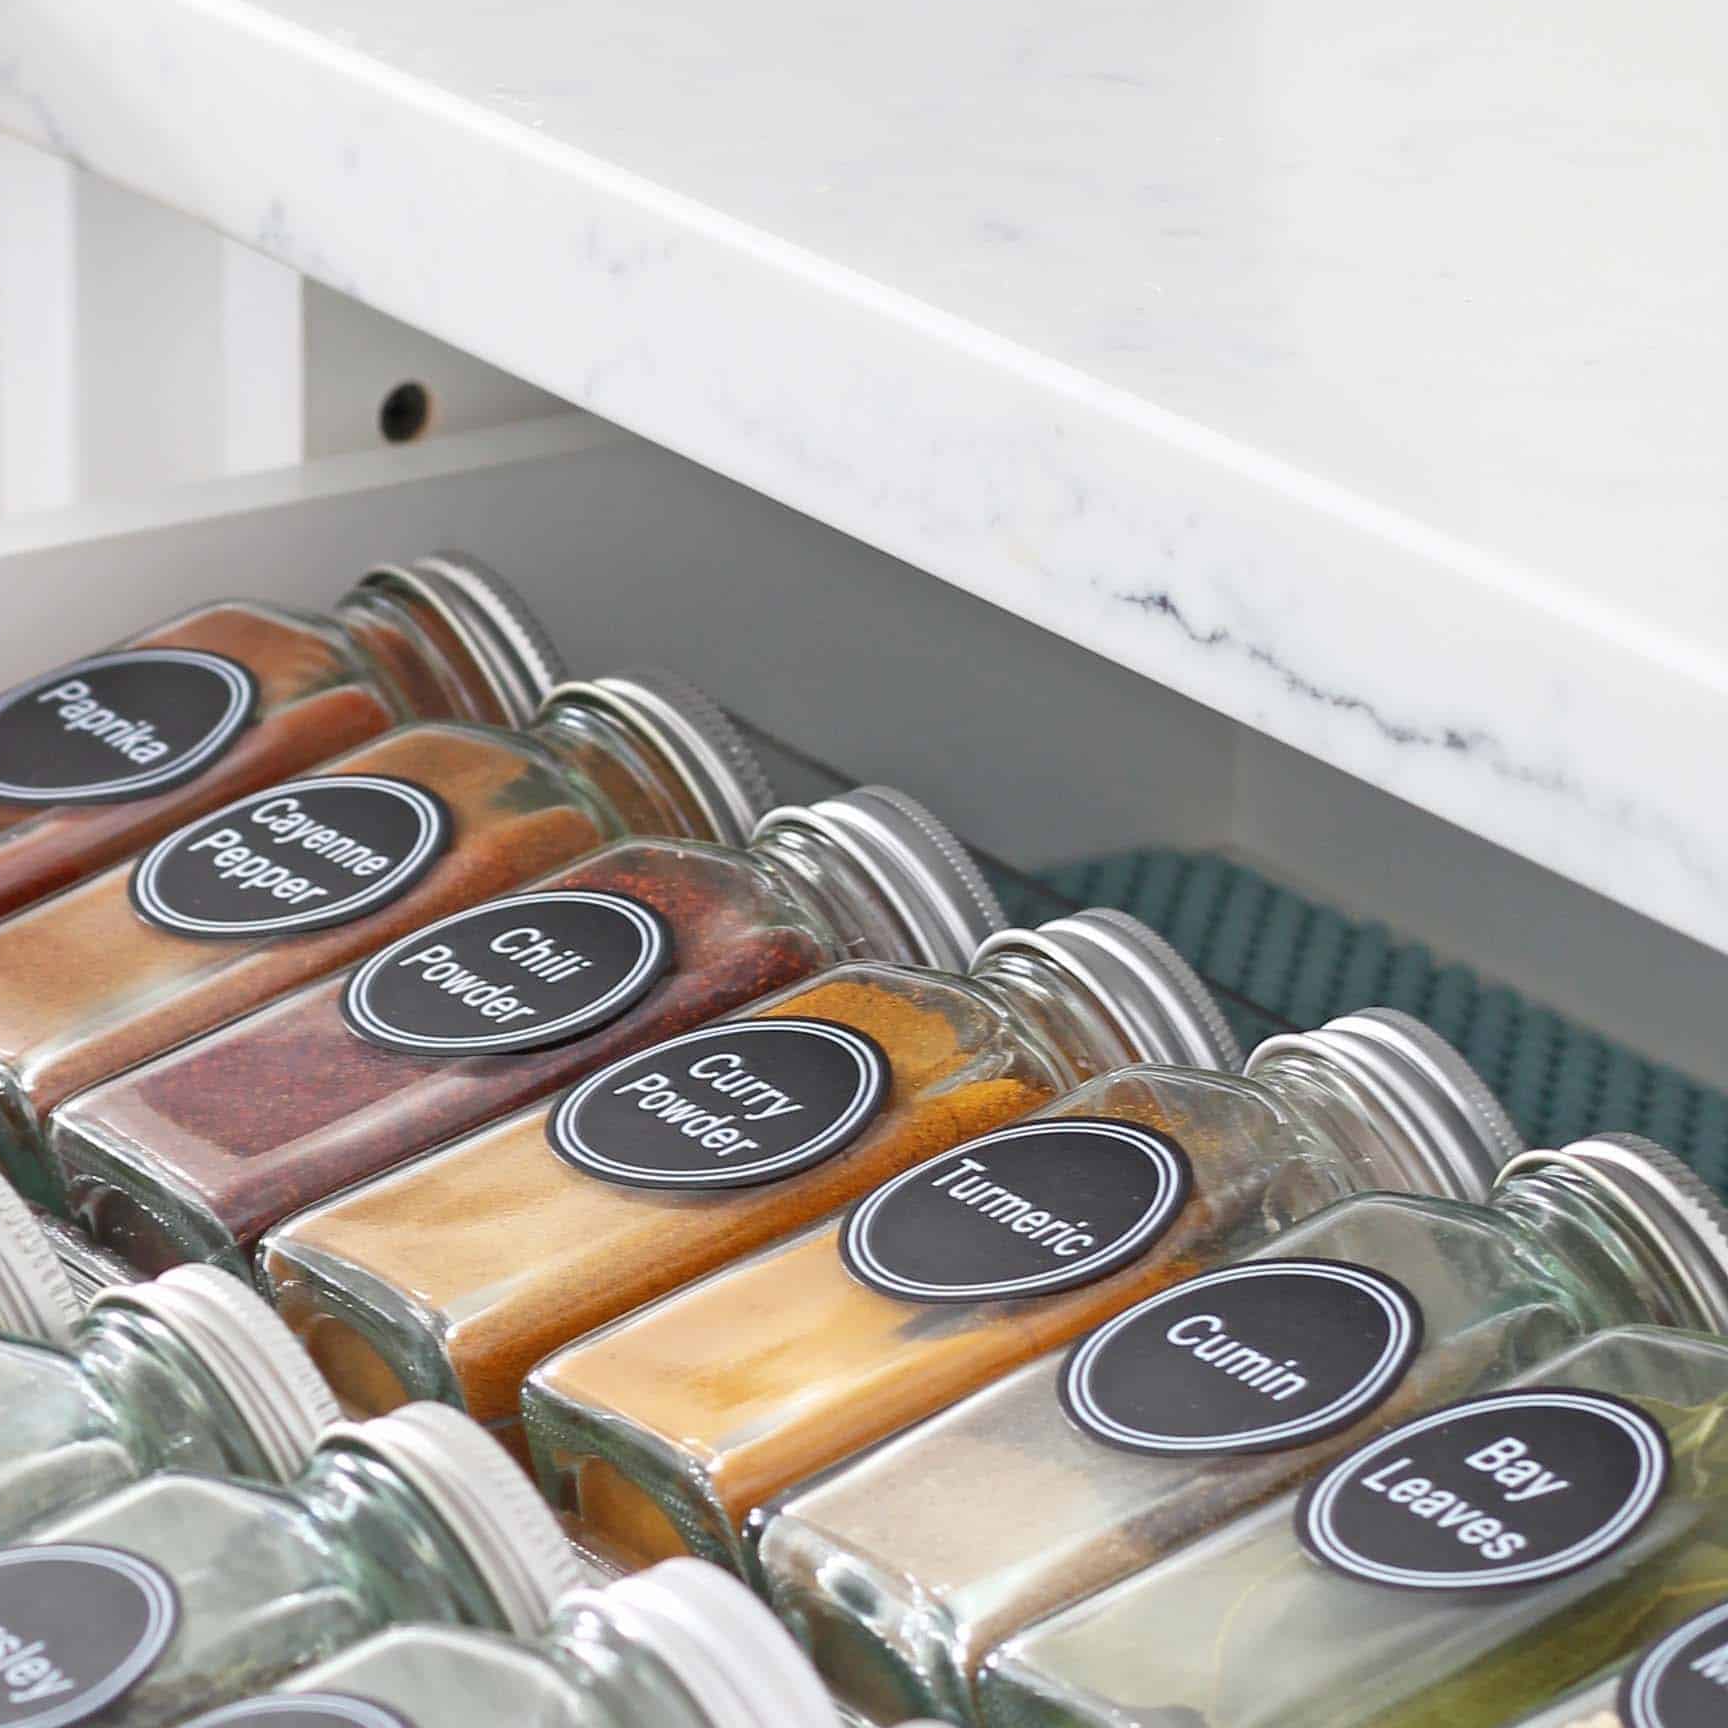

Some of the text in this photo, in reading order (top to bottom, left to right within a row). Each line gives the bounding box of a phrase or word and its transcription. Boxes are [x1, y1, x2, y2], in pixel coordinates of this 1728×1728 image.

[37, 680, 169, 764] Paprika
[187, 828, 328, 905] Pepper
[250, 797, 390, 877] Cayenne
[398, 944, 537, 1023] Powder
[488, 927, 596, 983] Chili
[613, 1072, 761, 1157] Powder
[688, 1053, 805, 1121] Curry
[931, 1157, 1094, 1257] Turmeric
[1166, 1314, 1308, 1401] Cumin
[1361, 1456, 1528, 1560] Leaves
[1464, 1436, 1571, 1502] Bay
